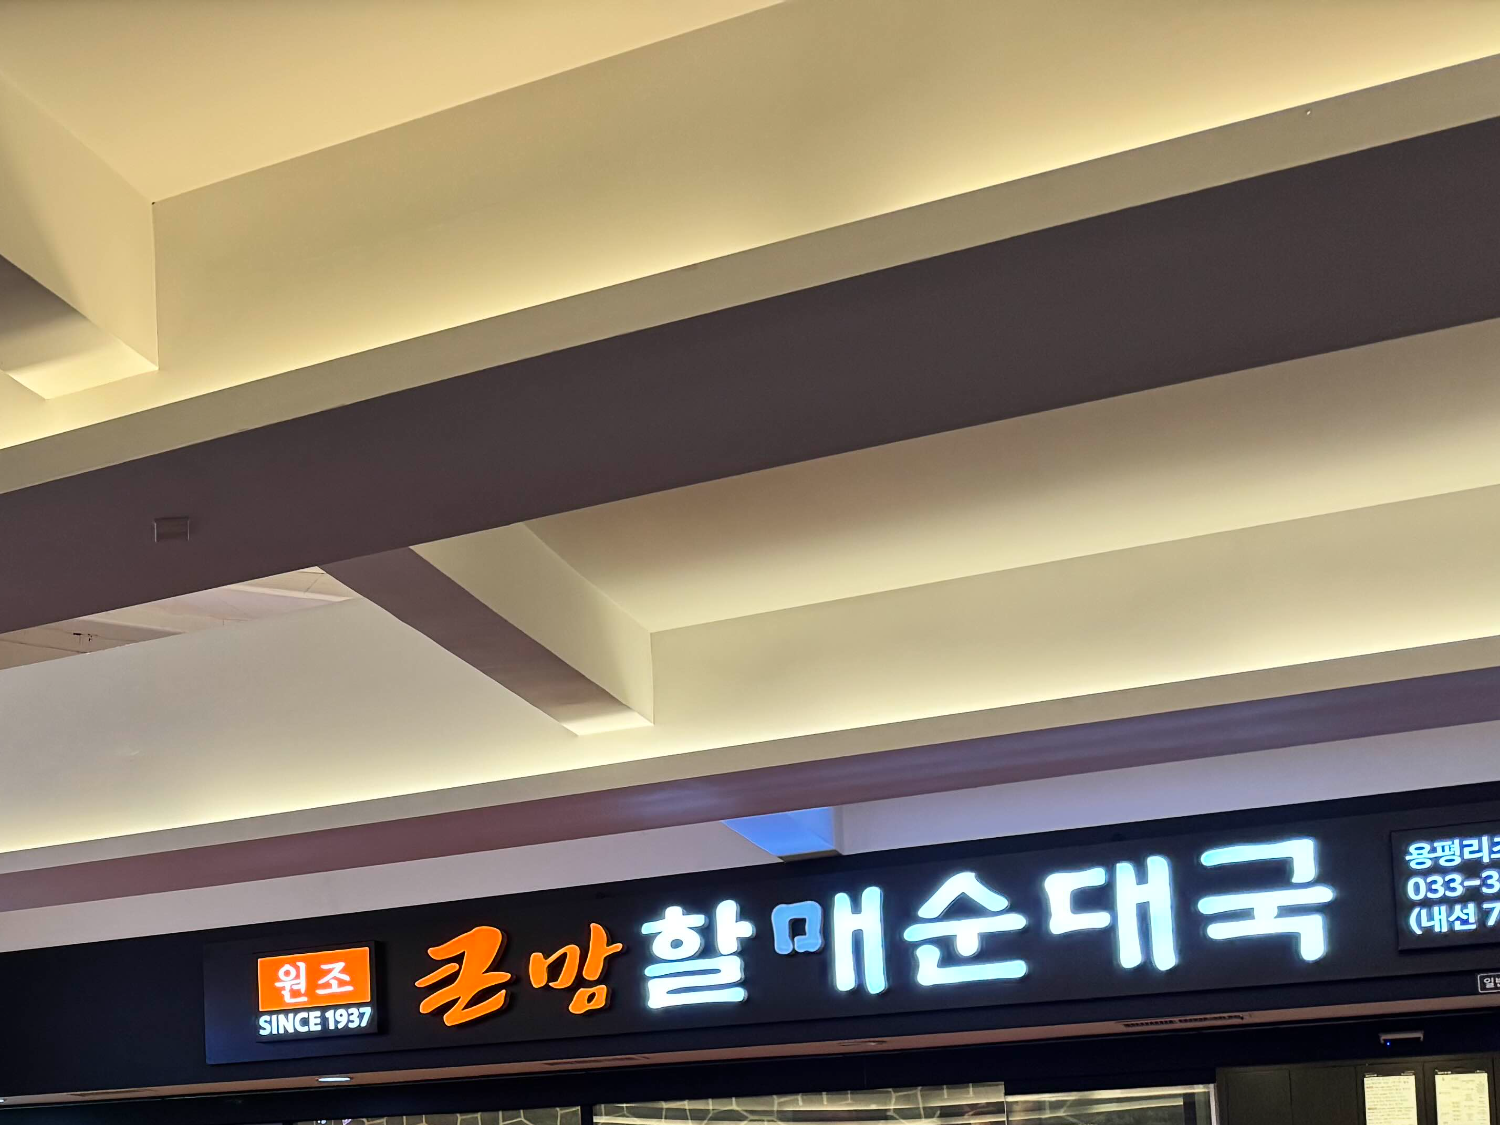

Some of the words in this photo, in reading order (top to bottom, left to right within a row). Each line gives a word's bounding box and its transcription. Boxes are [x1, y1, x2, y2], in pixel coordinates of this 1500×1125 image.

[1407, 869, 1500, 901] 033-3
[414, 922, 624, 1027] 큰맘
[640, 836, 1337, 1011] 할매순대국
[1409, 902, 1478, 935] (내선
[274, 958, 355, 1006] 원조
[258, 1009, 322, 1036] SINCE
[325, 1006, 371, 1033] 1937
